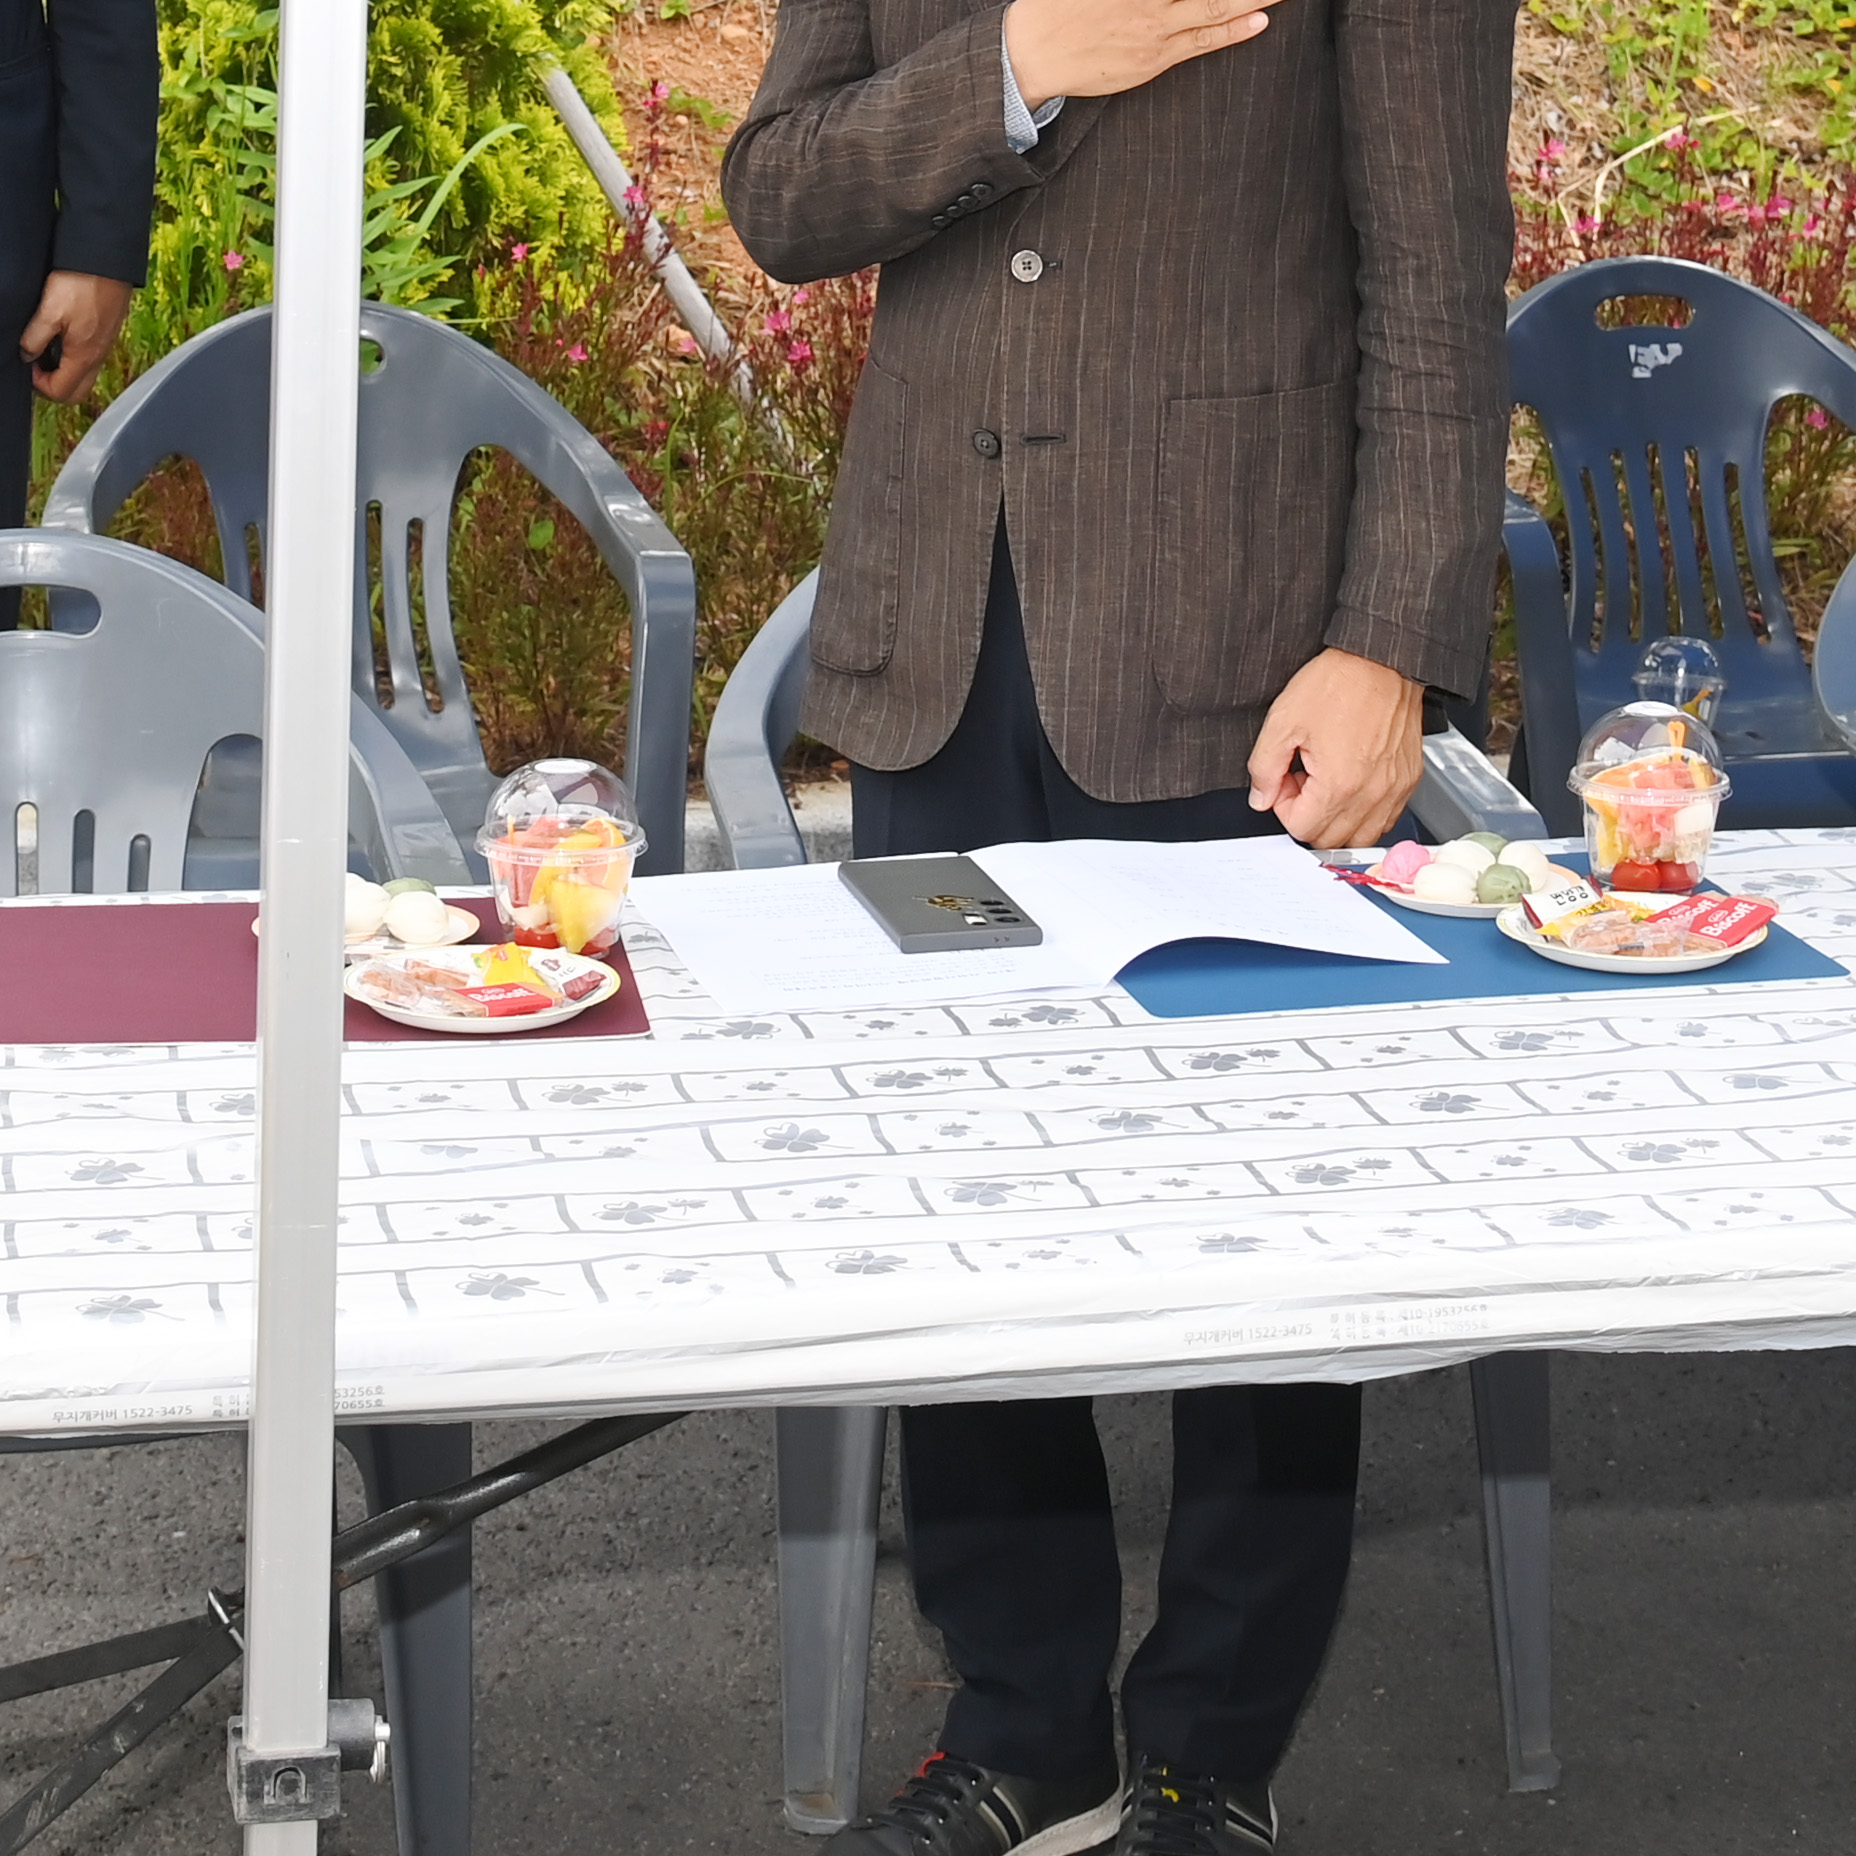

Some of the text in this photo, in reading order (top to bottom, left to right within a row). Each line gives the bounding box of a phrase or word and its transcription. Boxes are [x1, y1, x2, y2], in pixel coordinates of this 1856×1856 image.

[1699, 901, 1758, 936] Biscoff
[1248, 1323, 1313, 1340] 1522-3475
[52, 1404, 193, 1425] 무지개커버 1522-3475
